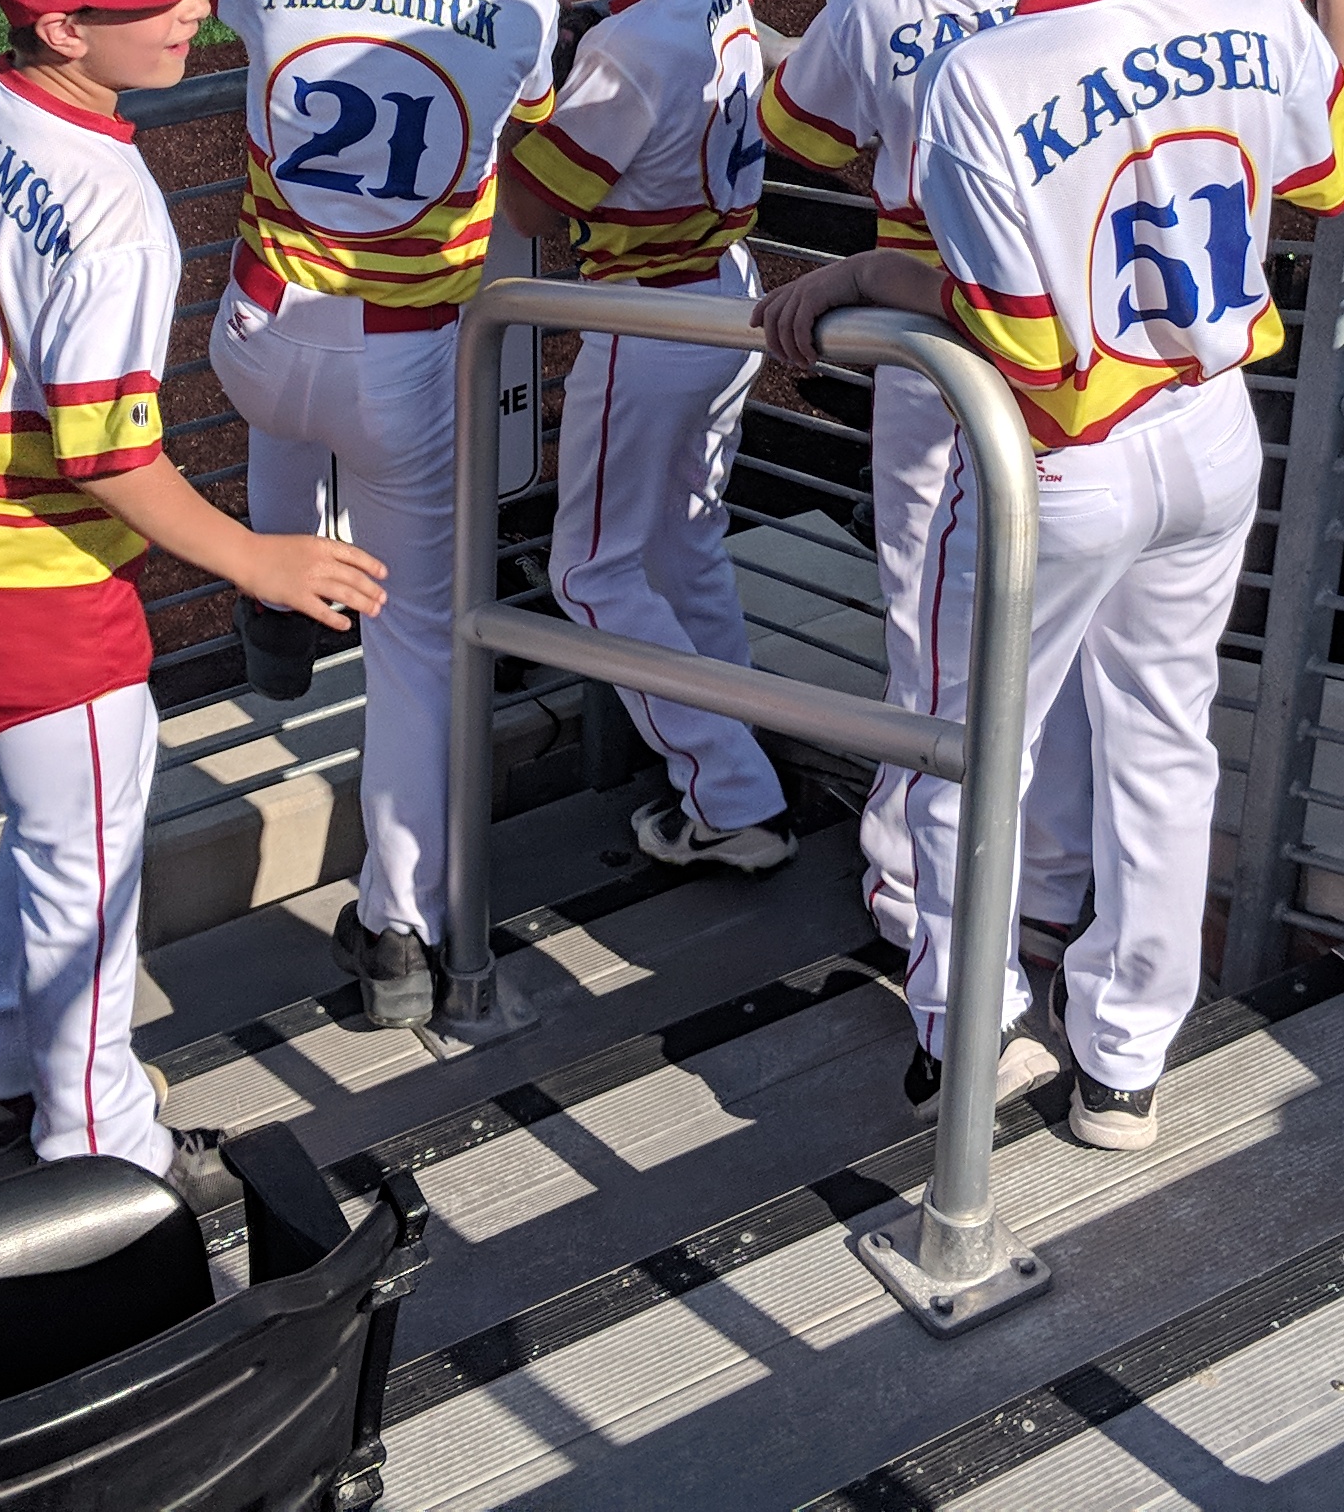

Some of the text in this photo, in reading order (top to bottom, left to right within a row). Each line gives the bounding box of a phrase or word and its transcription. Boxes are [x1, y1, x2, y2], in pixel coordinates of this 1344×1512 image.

[275, 76, 435, 201] 21
[1014, 29, 1281, 187] KASSEL
[1110, 179, 1264, 339] 51
